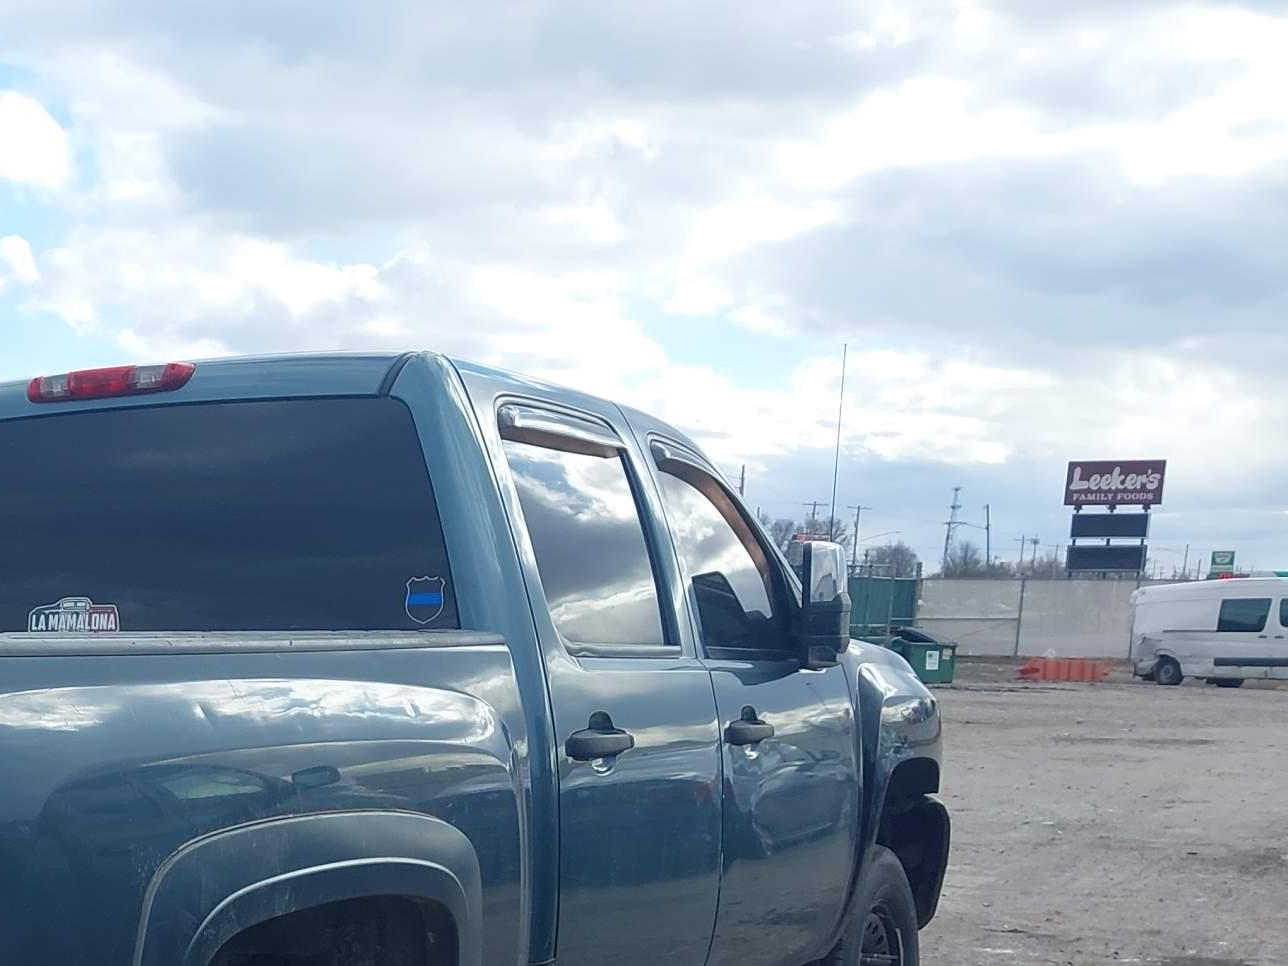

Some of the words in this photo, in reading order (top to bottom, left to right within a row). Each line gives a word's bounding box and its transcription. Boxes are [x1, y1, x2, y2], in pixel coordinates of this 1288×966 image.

[1069, 466, 1162, 490] Leeker's
[1072, 493, 1114, 501] FAMILY
[1116, 493, 1154, 501] FOODS
[31, 613, 46, 631] LA
[47, 613, 116, 631] MAMALONA
